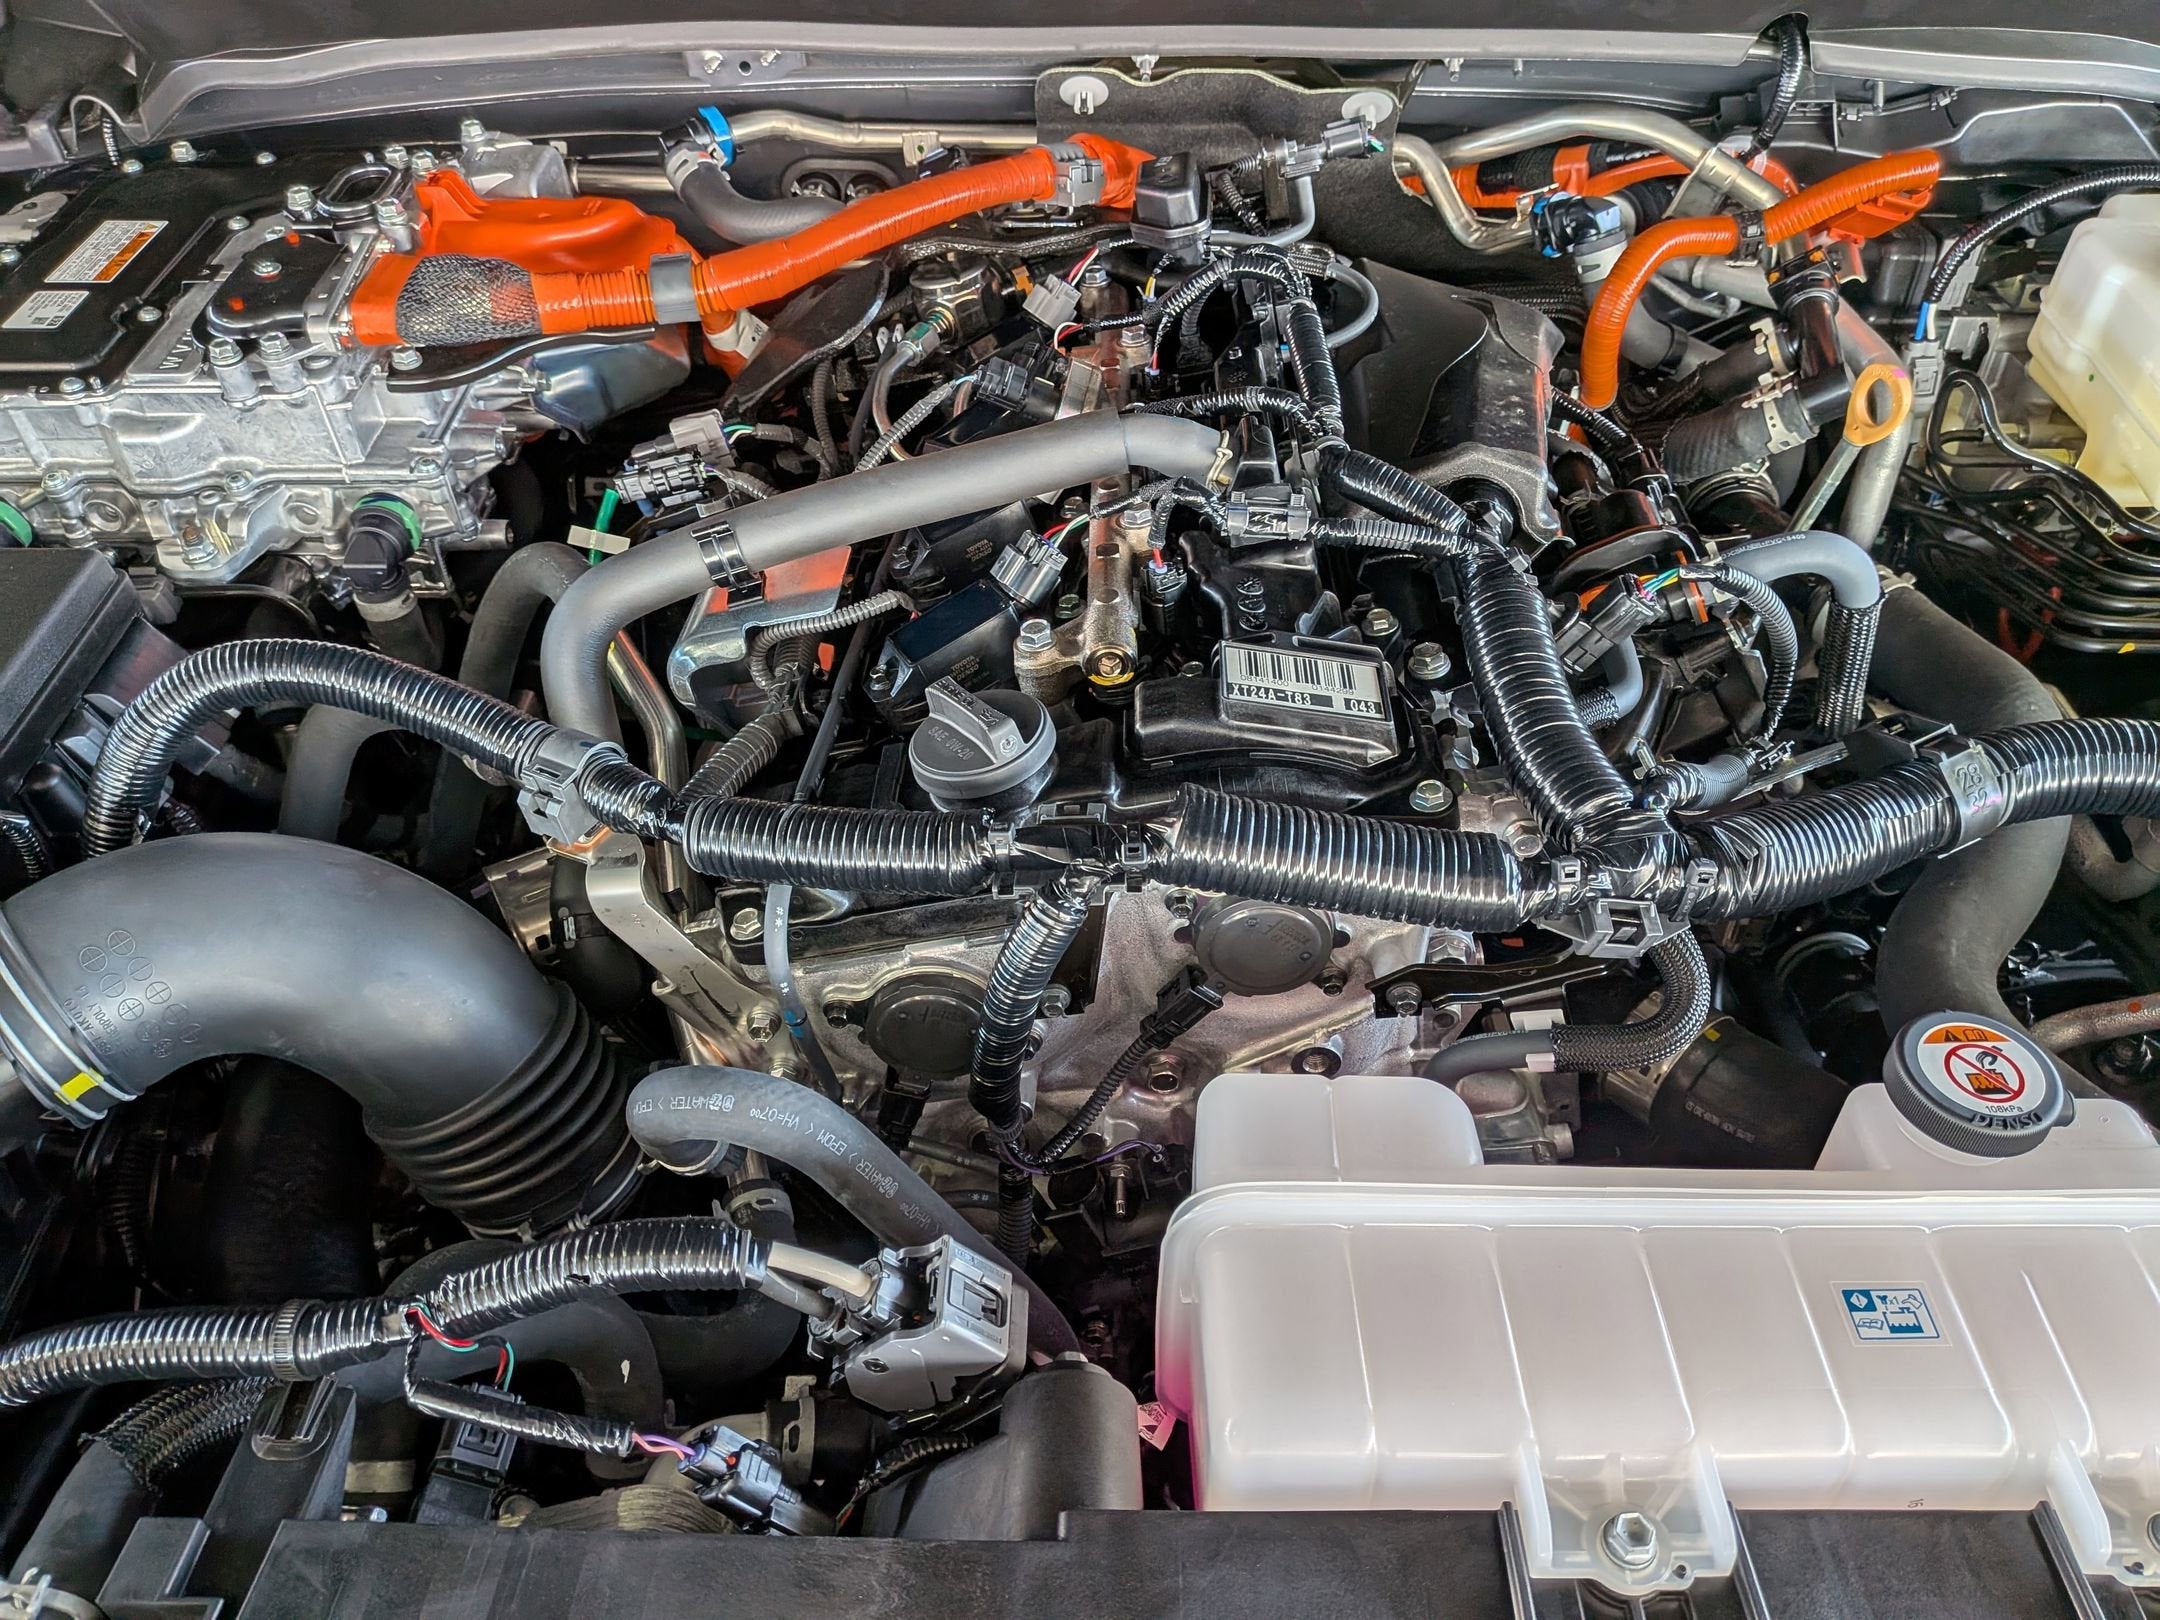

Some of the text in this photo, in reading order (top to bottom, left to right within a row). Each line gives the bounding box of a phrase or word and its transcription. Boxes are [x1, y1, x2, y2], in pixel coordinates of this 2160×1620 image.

[1231, 683, 1376, 714] XT24A-T83 043
[927, 725, 950, 743] SAE
[671, 1096, 709, 1110] WATER
[1984, 1105, 2024, 1114] 108kPa
[1970, 1112, 2043, 1131] DENSO
[815, 1128, 848, 1156] EPDM
